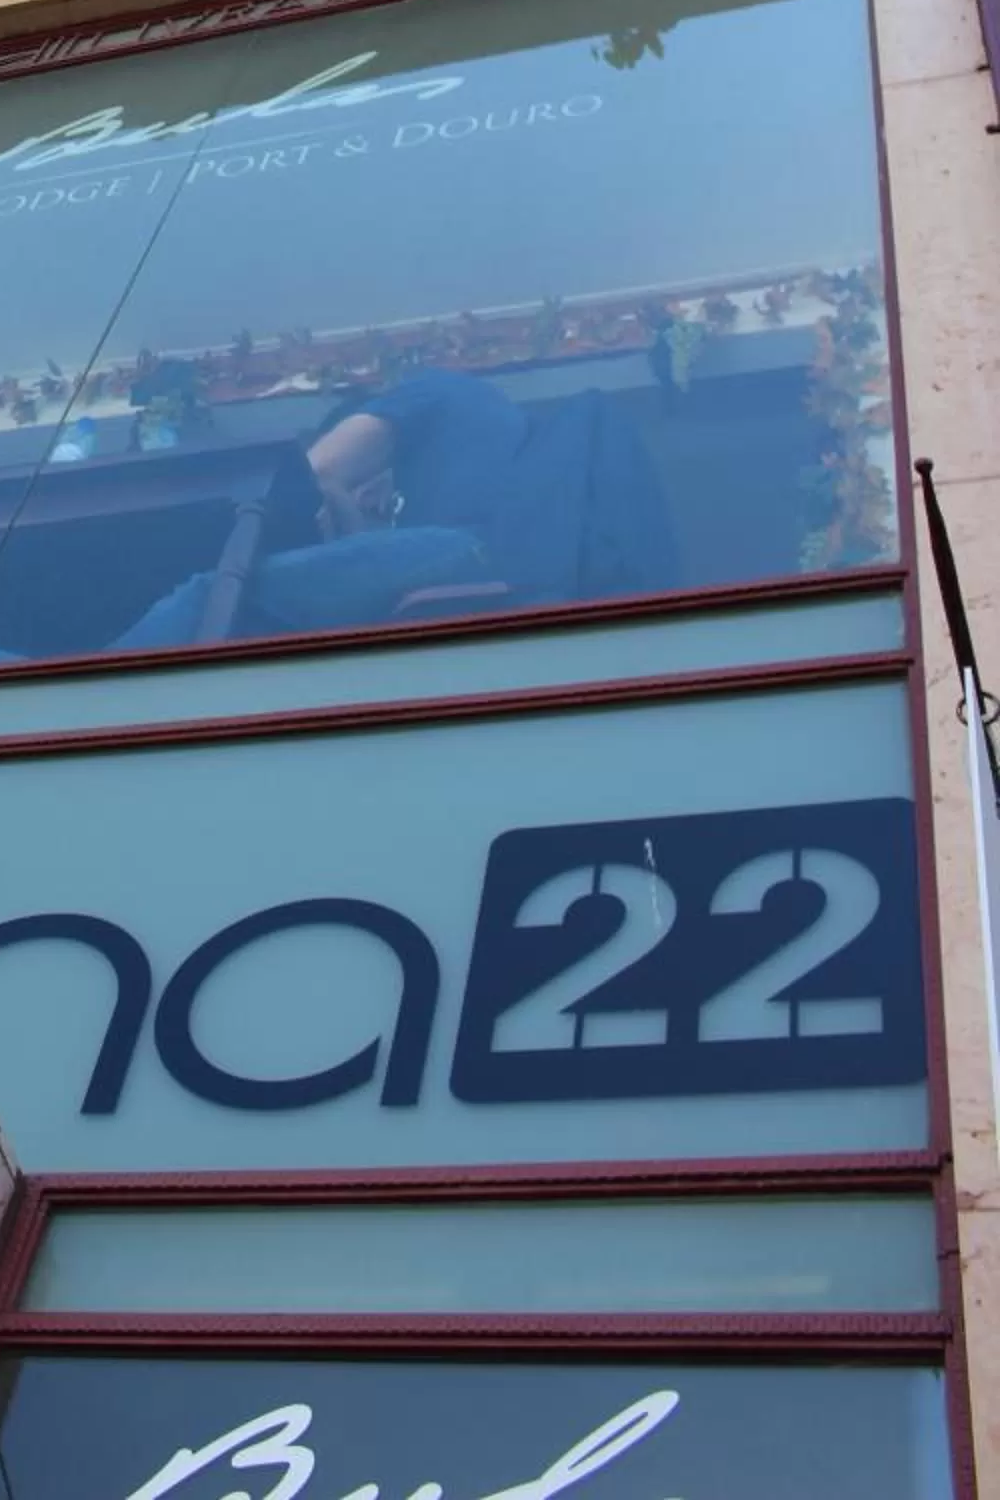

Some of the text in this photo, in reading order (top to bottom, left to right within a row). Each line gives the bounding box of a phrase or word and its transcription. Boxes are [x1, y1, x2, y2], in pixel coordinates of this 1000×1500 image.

[187, 143, 320, 185] PORT
[334, 135, 369, 158] &
[391, 94, 603, 150] DOURO
